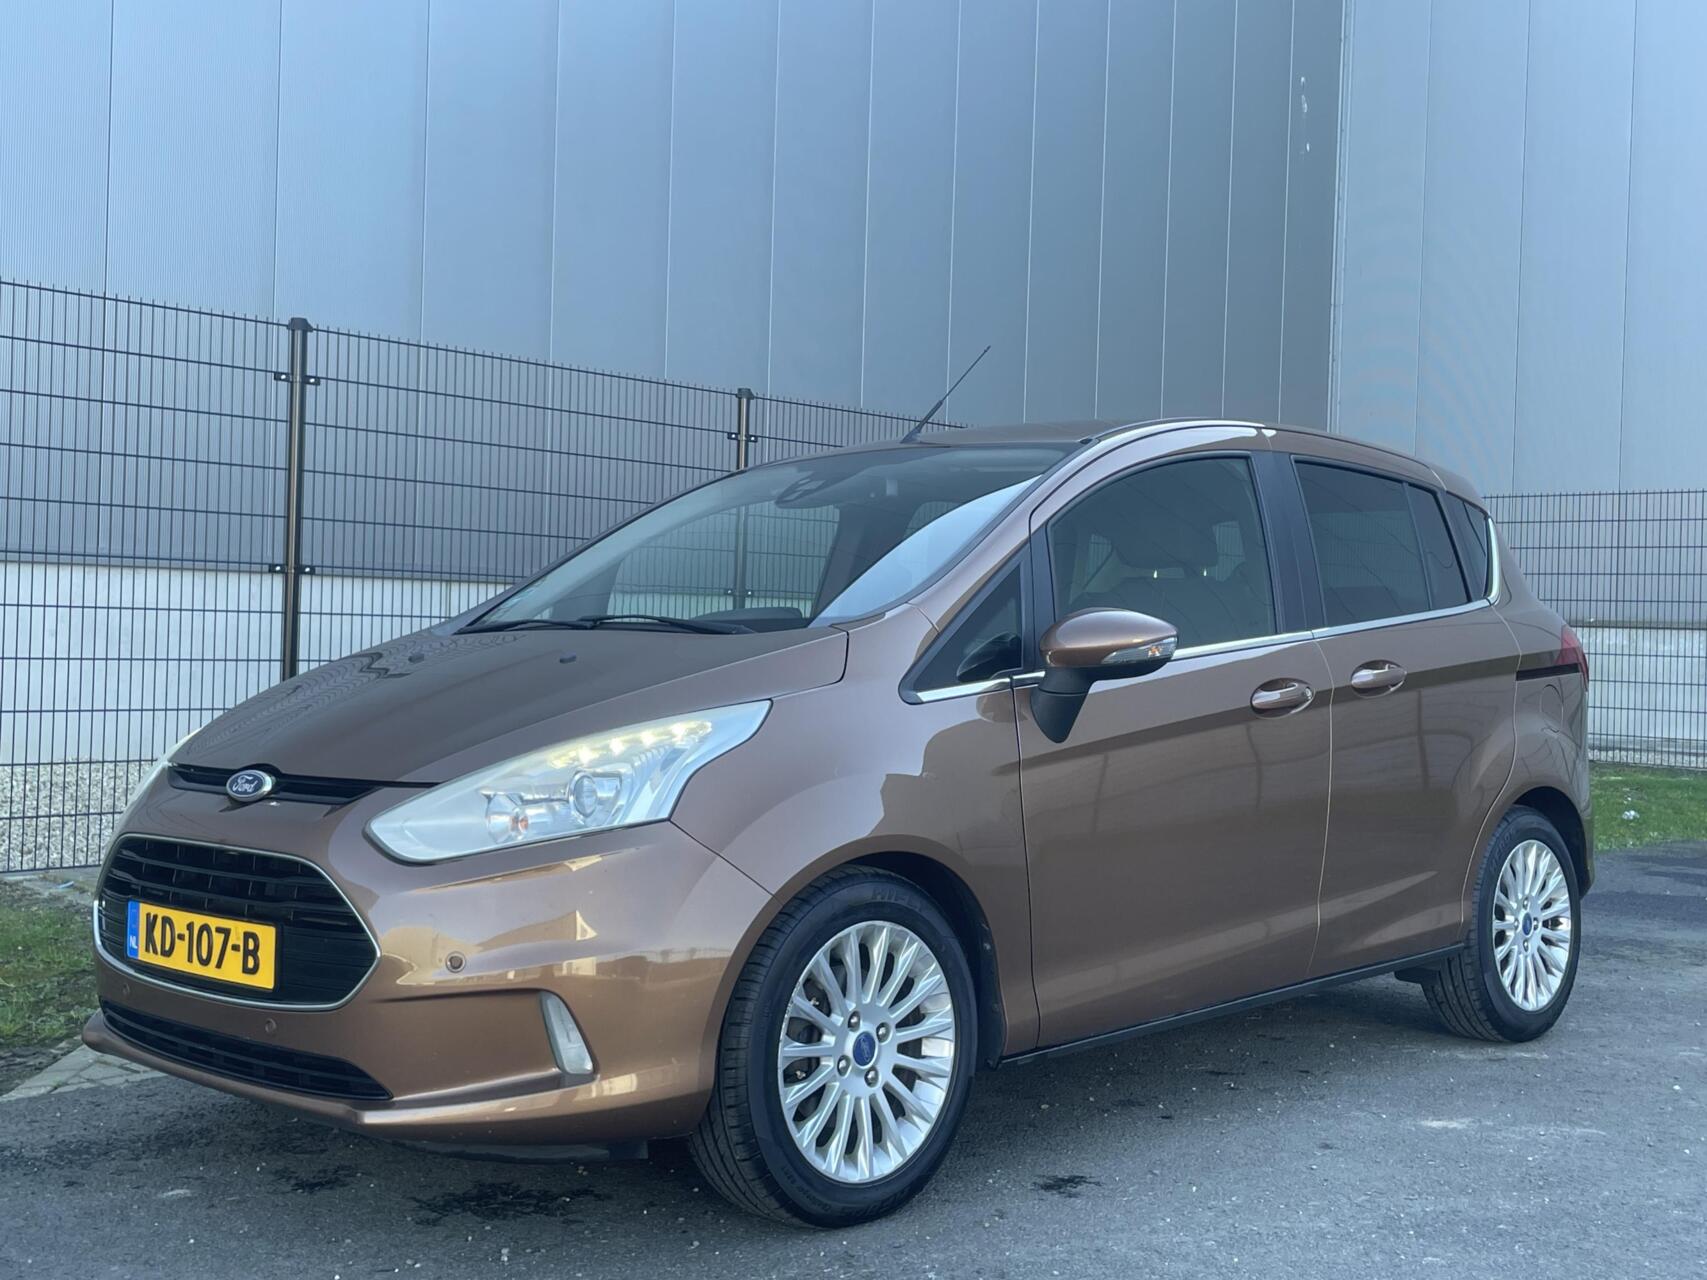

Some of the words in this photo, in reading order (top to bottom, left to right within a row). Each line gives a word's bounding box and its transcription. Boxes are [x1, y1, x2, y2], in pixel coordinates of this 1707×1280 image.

[232, 774, 258, 792] Ford
[129, 935, 138, 949] NL
[144, 912, 260, 975] KD-107-B
